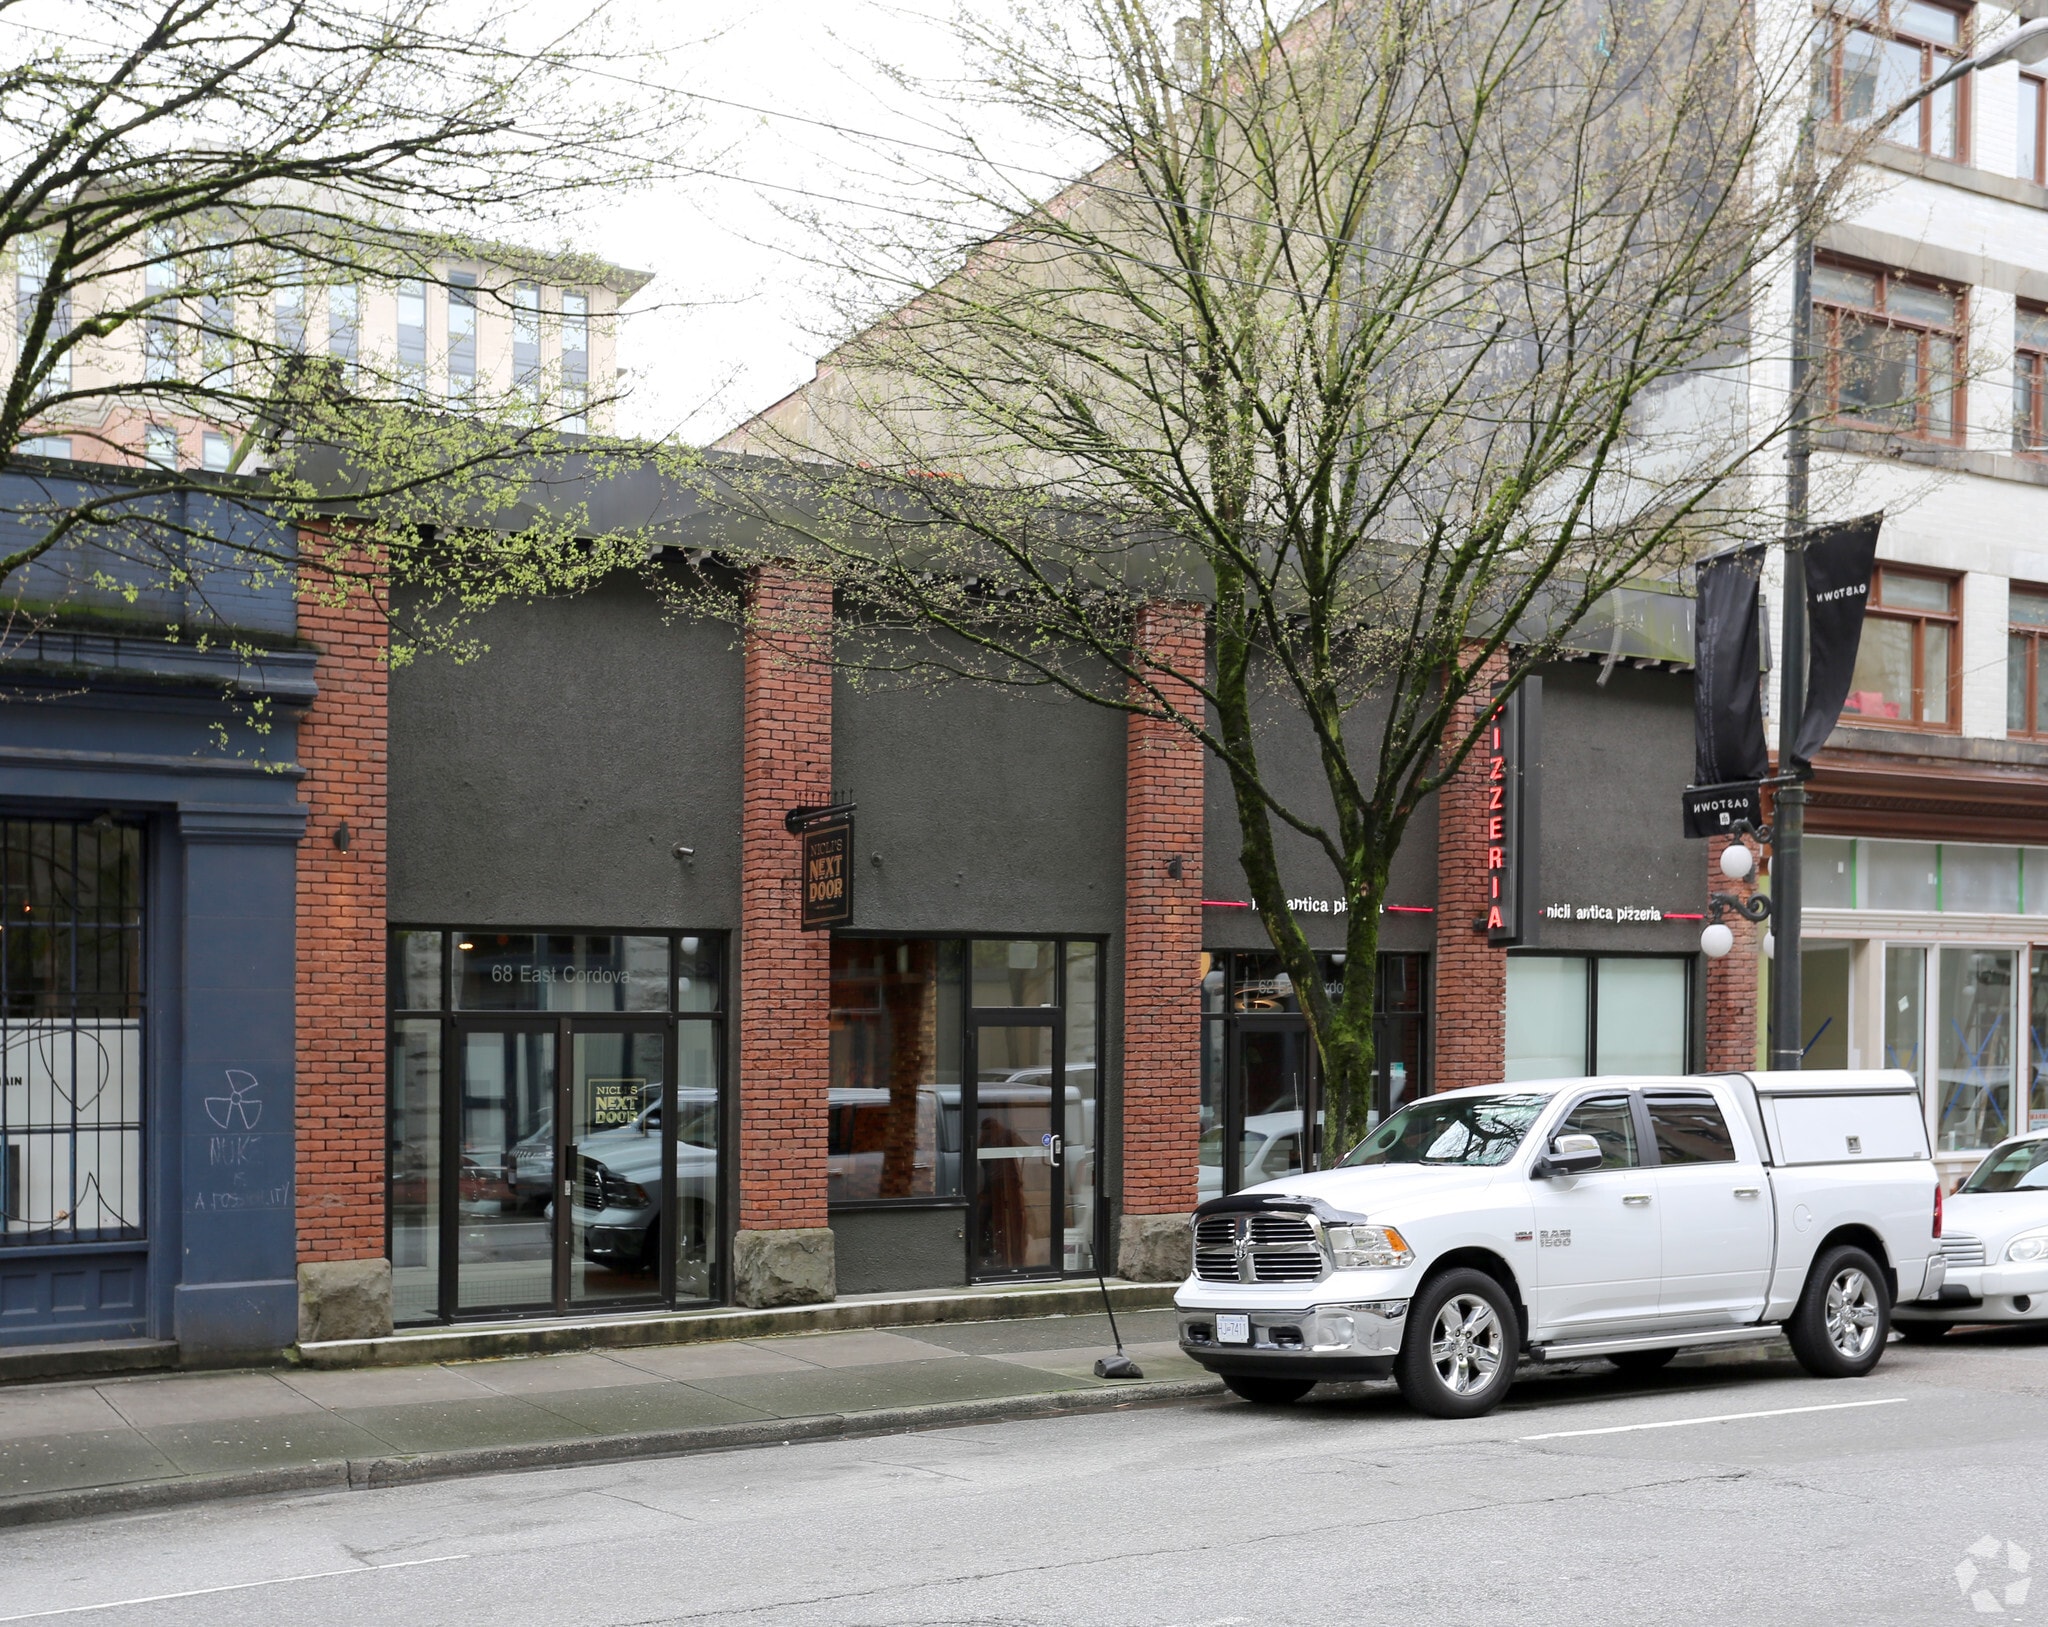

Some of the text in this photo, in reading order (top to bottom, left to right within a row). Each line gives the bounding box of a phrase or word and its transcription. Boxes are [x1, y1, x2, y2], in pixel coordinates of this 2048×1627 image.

[810, 838, 843, 857] NICLI'S
[809, 854, 843, 882] NEXT
[809, 877, 843, 903] DOOR
[1286, 896, 1329, 913] antica
[1546, 903, 1662, 923] nicli antica pizzeria
[491, 964, 630, 984] 68 East Cordova
[1259, 979, 1274, 994] 62
[595, 1096, 639, 1111] NEXT
[595, 1110, 639, 1124] DOOR
[1540, 1238, 1571, 1247] 1500
